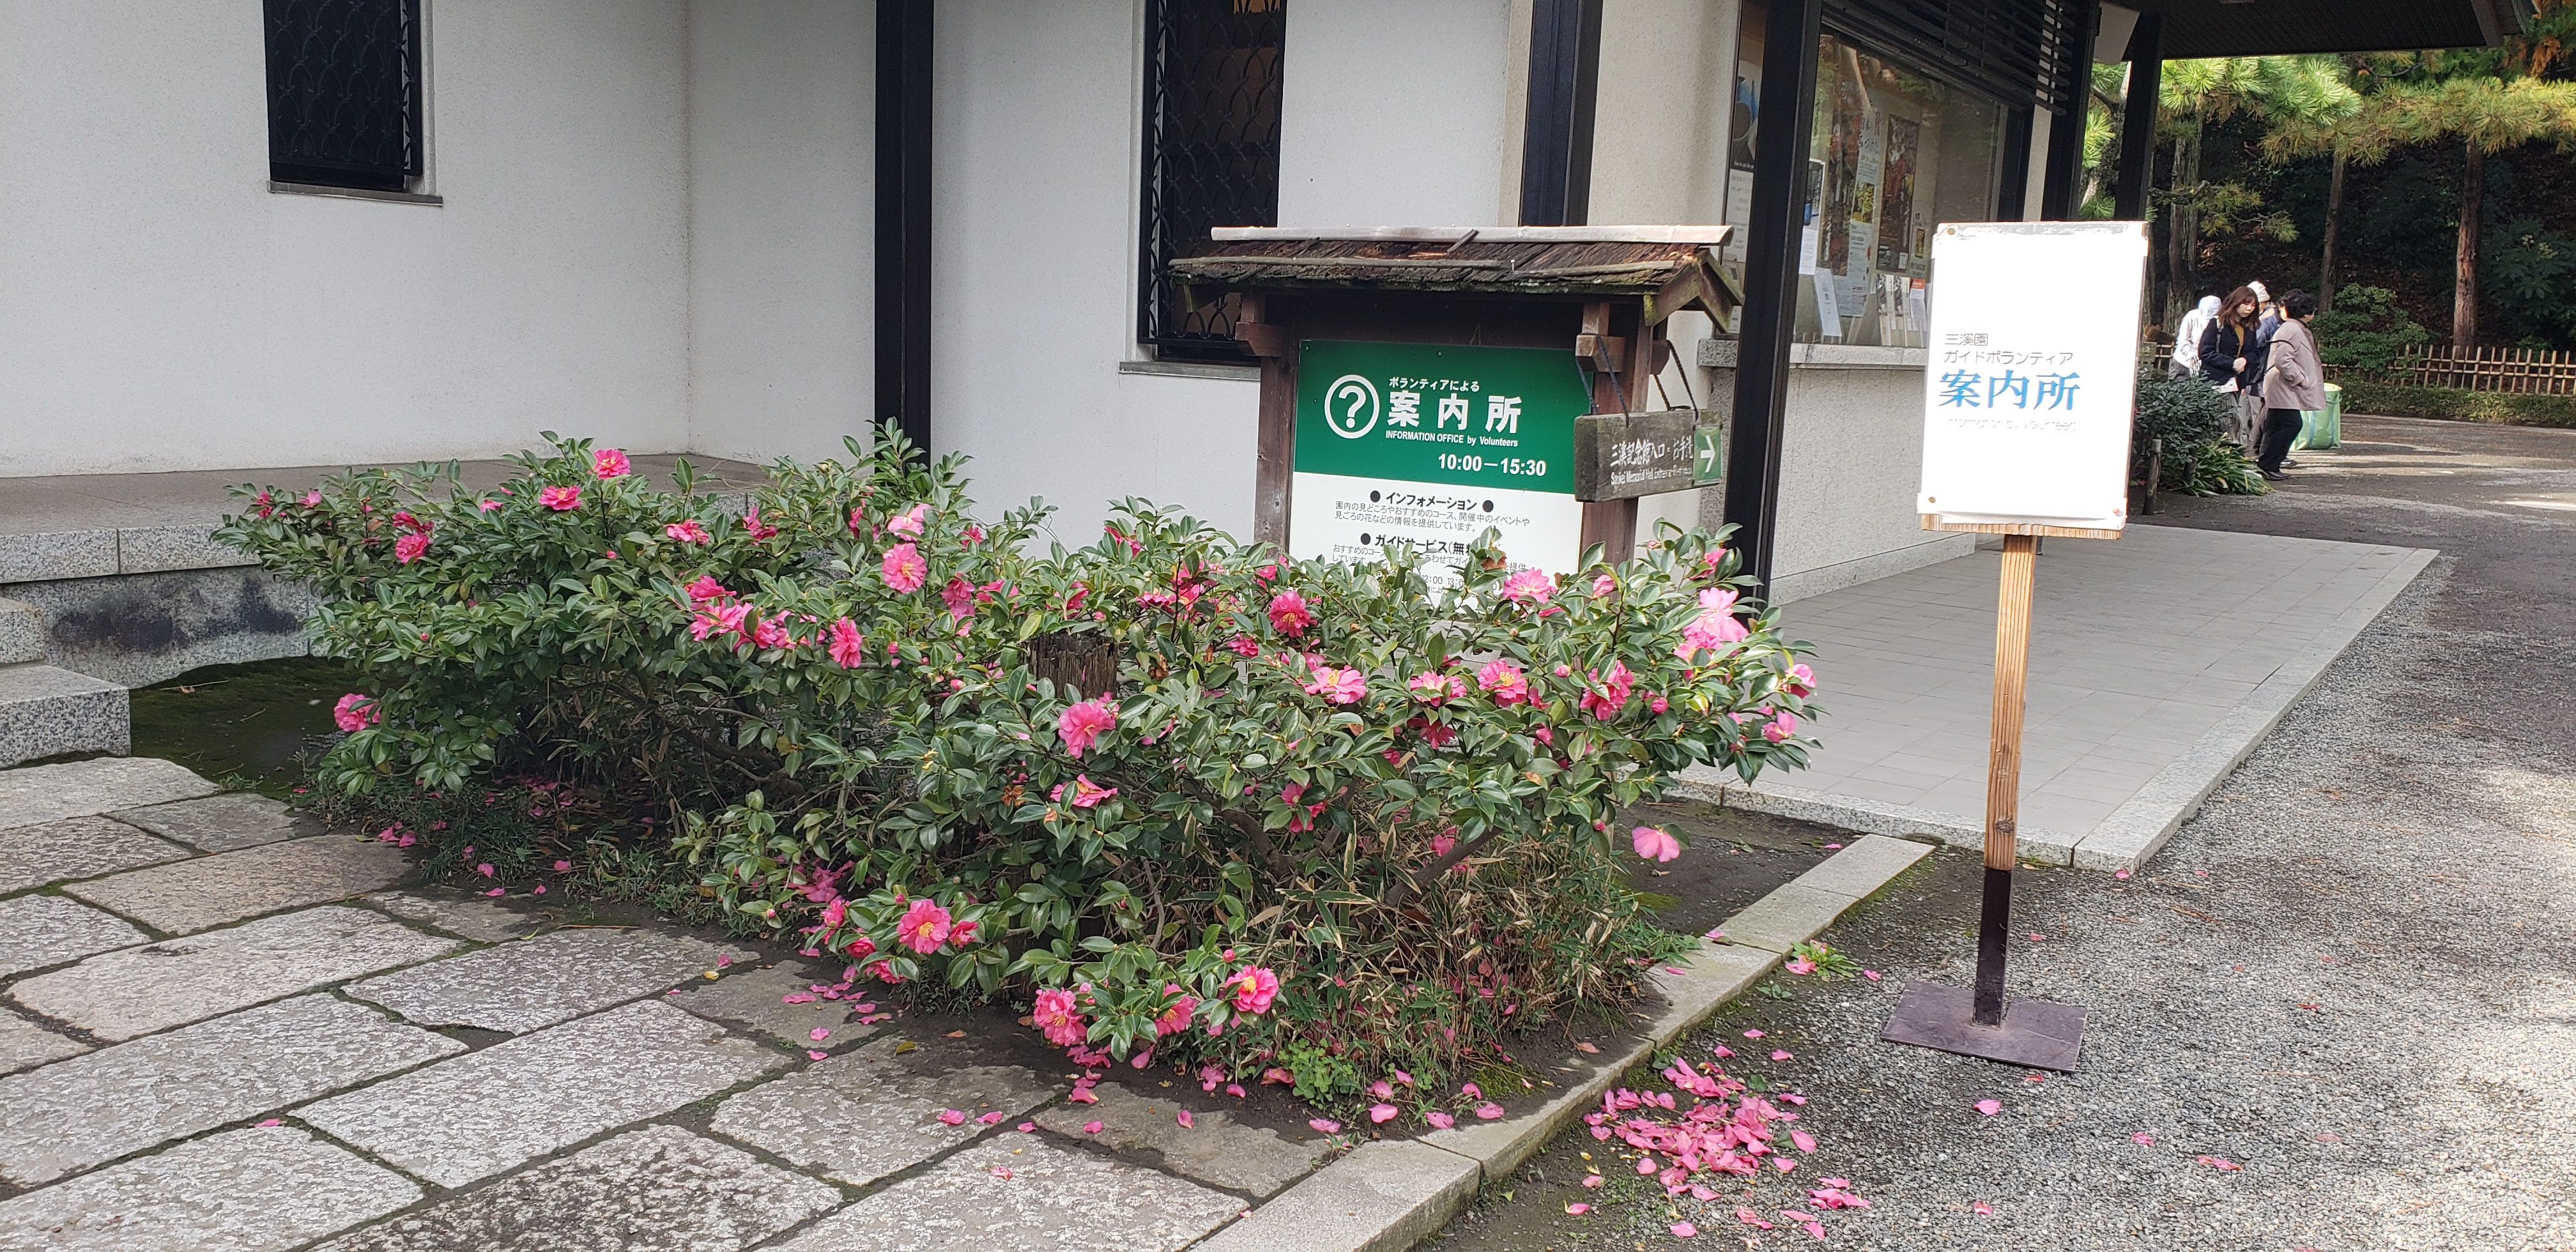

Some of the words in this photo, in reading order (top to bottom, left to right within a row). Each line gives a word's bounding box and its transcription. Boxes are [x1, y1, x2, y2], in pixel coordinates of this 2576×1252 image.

[1945, 333, 1988, 346] 三溪園
[1943, 350, 2073, 365] ガイドボランティア
[1389, 376, 1480, 392] ボランティアによる
[1938, 369, 2080, 410] 案内所
[1387, 390, 1522, 434] 案内所
[1385, 430, 1436, 441] INFORMATION
[1437, 433, 1464, 443] OFFICE
[1467, 436, 1476, 447] by
[1480, 436, 1518, 447] Volunteers
[1386, 492, 1477, 511] インフォメーション
[1335, 510, 1475, 533] 見ごろの花などの情報を提供しています。
[1336, 501, 1529, 526] 園内の見どころやおすすめのコース、開催中のイベントや
